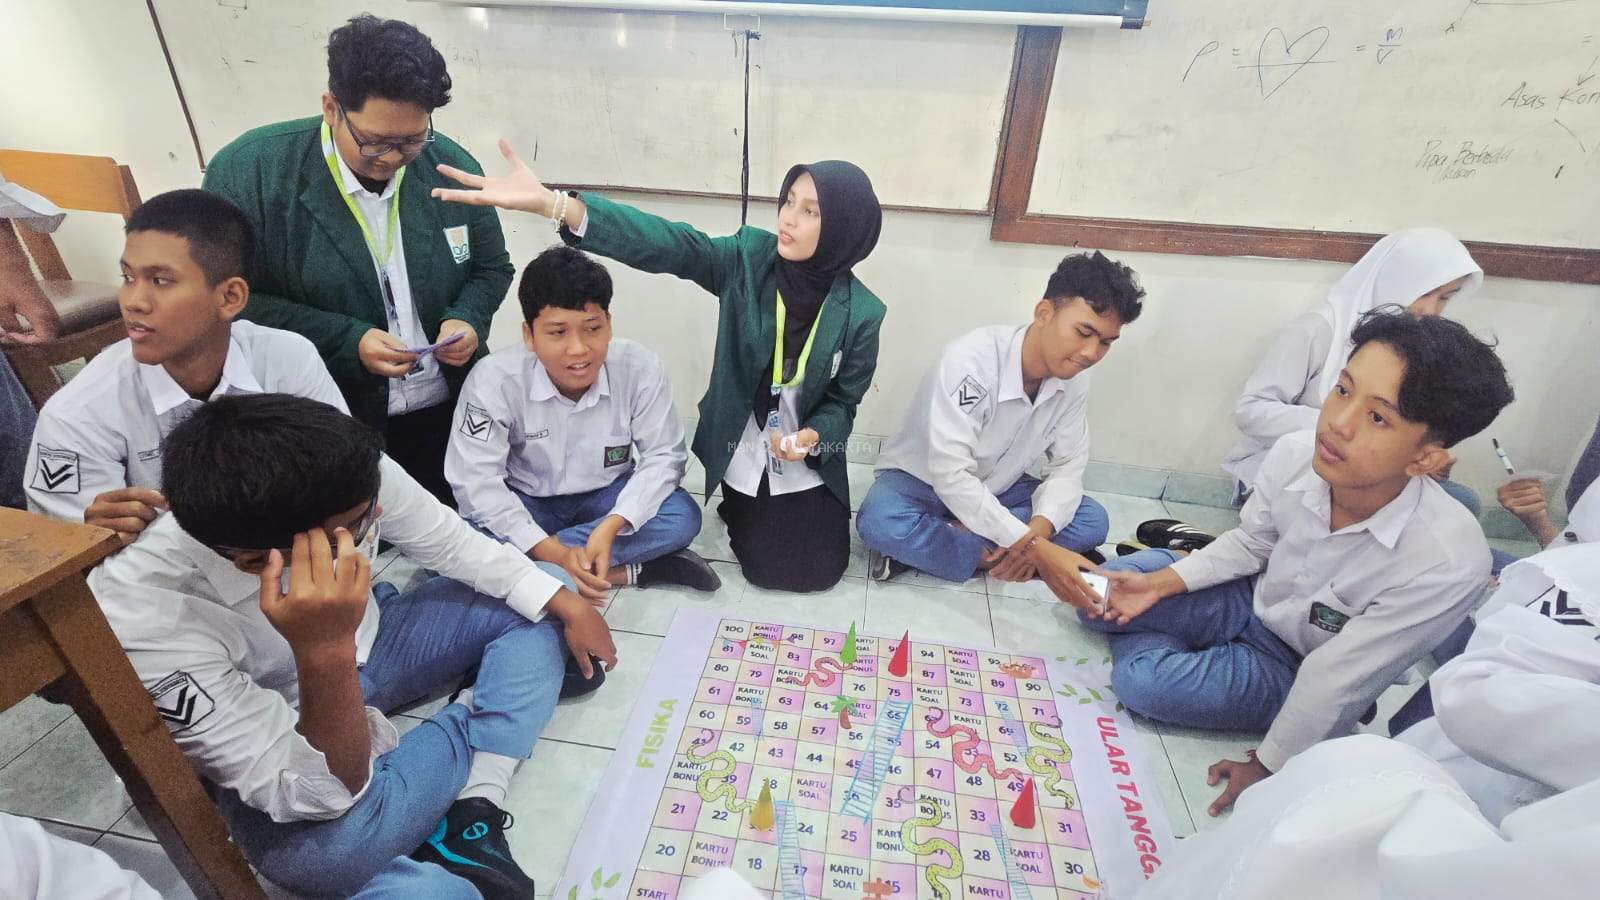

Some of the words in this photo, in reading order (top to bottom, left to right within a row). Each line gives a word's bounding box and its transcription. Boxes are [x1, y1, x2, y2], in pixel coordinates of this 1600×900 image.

[725, 625, 744, 633] 100
[755, 625, 779, 633] KARTU
[823, 638, 836, 646] 97
[750, 644, 774, 652] KARTU
[750, 651, 769, 660] SOAL
[787, 652, 800, 661] 83
[920, 650, 934, 658] 94
[948, 649, 973, 657] KARTU
[952, 657, 971, 665] SOAL
[714, 664, 729, 672] 80
[749, 670, 762, 678] 79
[778, 669, 803, 677] KARTU
[922, 670, 935, 679] 87
[949, 669, 976, 678] KARTU
[954, 678, 974, 687] SOAL
[991, 679, 1005, 688] 89
[1025, 683, 1041, 691] 90
[708, 686, 721, 695] 61
[738, 687, 764, 695] KARTU
[853, 683, 866, 692] 76
[888, 687, 901, 696] 75
[917, 687, 943, 695] KARTU
[779, 697, 792, 705] 63
[920, 696, 939, 704] SOAL
[958, 697, 972, 706] 73
[814, 701, 829, 711] 64
[995, 702, 1009, 712] 72
[699, 710, 715, 719] 60
[1032, 707, 1044, 716] 71
[736, 716, 751, 725] 59
[954, 715, 981, 725] KARTU
[773, 721, 788, 730] 58
[635, 699, 678, 768] FISIKA
[811, 726, 826, 735] 57
[849, 732, 863, 740] 56
[729, 742, 745, 752] 42
[925, 740, 940, 749] 54
[768, 748, 784, 758] 43
[806, 753, 823, 762] 44
[1004, 753, 1018, 762] 52
[677, 761, 707, 771] KARTU
[845, 759, 861, 769] 45
[673, 772, 700, 782] BONU
[926, 768, 942, 779] 47
[797, 778, 826, 788] KARTU
[966, 776, 982, 786] 48
[1007, 781, 1024, 792] 49
[798, 789, 820, 799] SOAL
[1096, 716, 1131, 776] ULAR
[1117, 781, 1162, 881] TANGG
[886, 797, 901, 808] 35
[671, 803, 686, 814] 21
[712, 810, 728, 821] 22
[969, 809, 986, 821] 33
[798, 822, 814, 835] 24
[1057, 822, 1073, 834] 31
[841, 830, 857, 842] 25
[877, 829, 902, 838] KART
[655, 844, 676, 856] 20
[695, 842, 728, 854] KARTU
[877, 842, 905, 852] BONU
[973, 849, 991, 861] 28
[747, 858, 763, 870] 18
[1064, 862, 1084, 875] 30
[793, 863, 808, 877] 17
[830, 863, 864, 876] KARTU
[832, 879, 857, 891] SOAL
[968, 885, 1004, 899] KARTU
